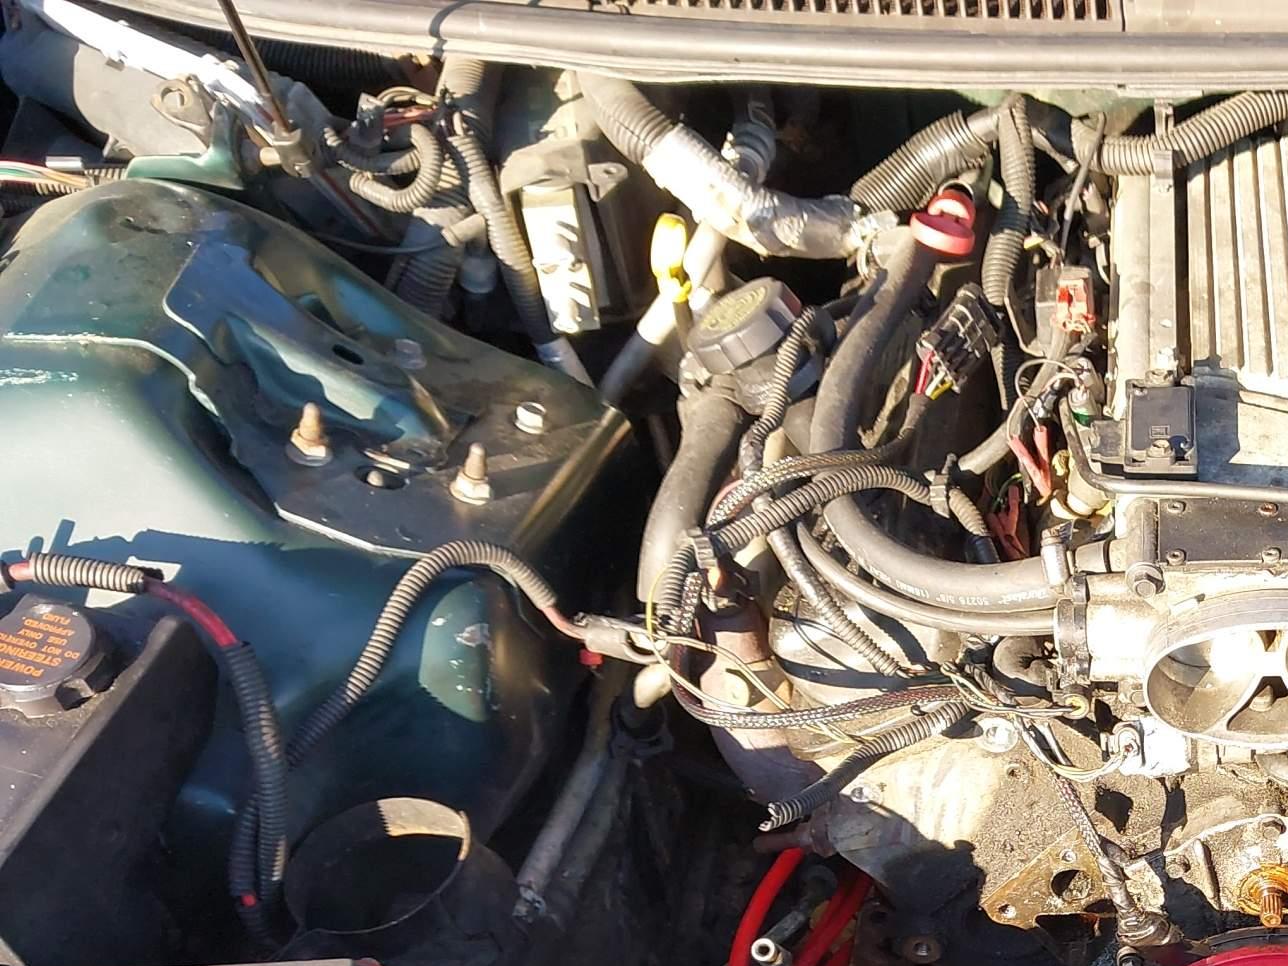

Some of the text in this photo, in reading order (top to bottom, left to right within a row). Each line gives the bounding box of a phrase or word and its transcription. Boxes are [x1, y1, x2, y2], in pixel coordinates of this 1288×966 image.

[42, 613, 71, 625] FLUID
[17, 628, 68, 646] USE ONLY
[41, 645, 62, 656] NOT
[64, 651, 80, 660] DO
